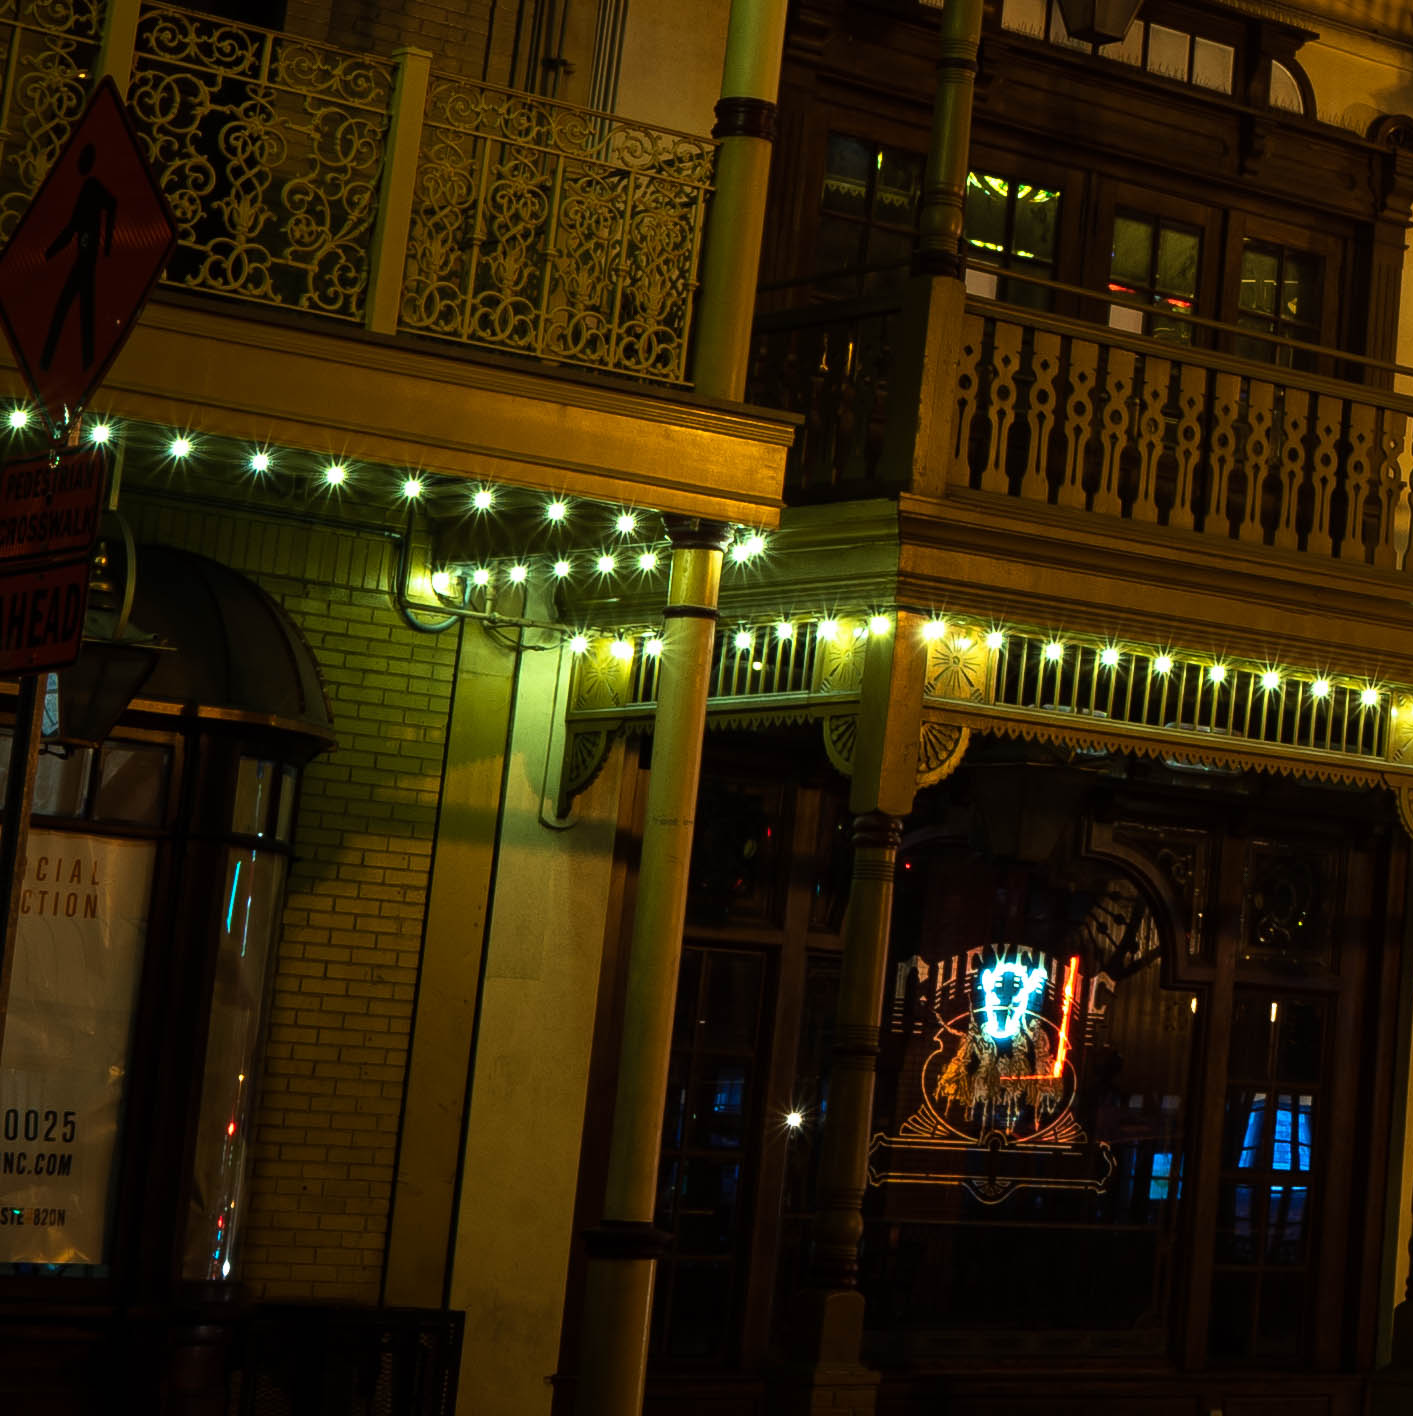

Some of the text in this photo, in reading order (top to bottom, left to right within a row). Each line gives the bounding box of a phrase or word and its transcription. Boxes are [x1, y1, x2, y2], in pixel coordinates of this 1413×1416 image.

[0, 584, 80, 650] HEAD
[24, 856, 99, 885] CIAL
[5, 1109, 76, 1142] 0025
